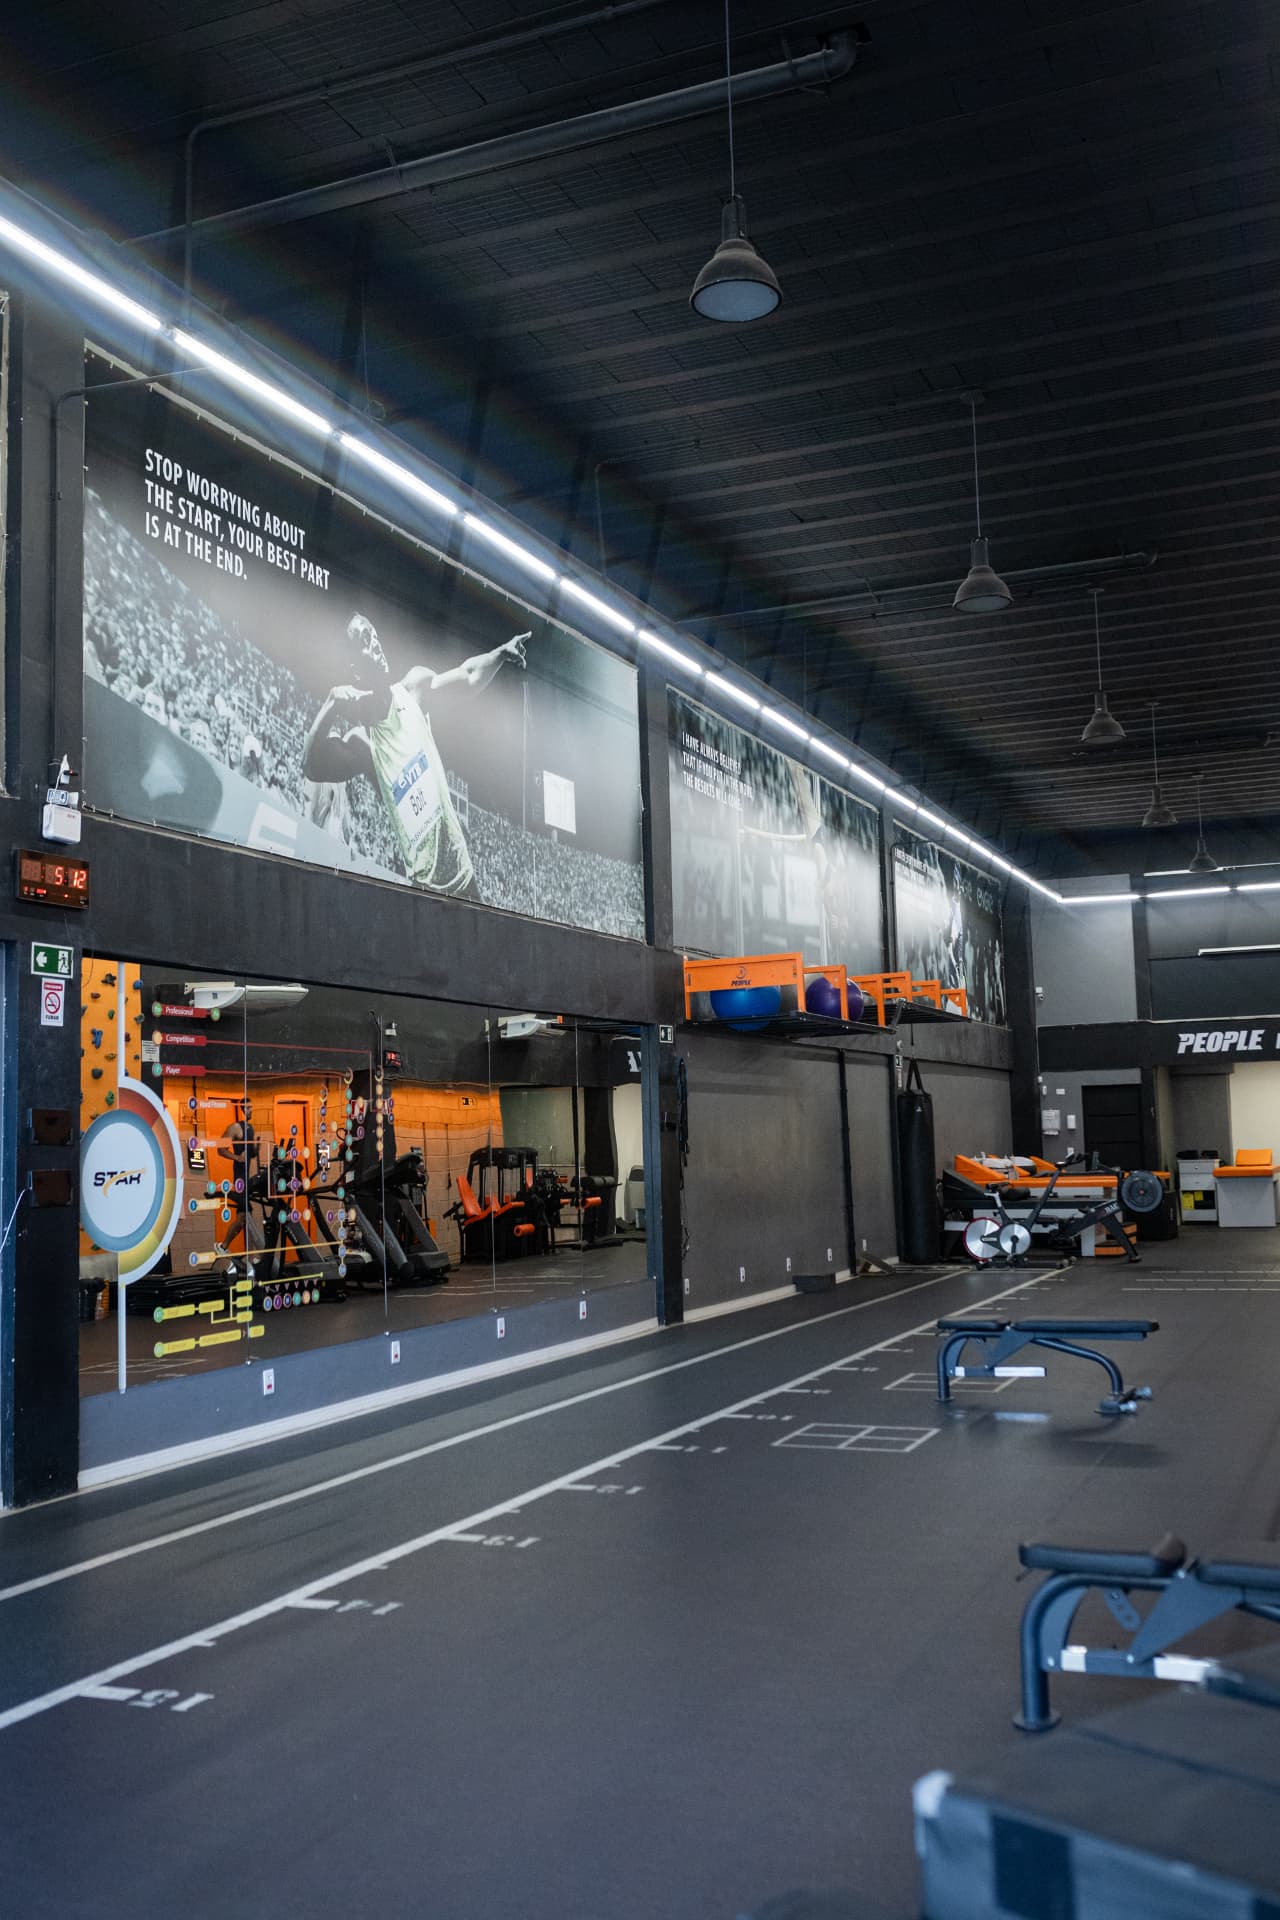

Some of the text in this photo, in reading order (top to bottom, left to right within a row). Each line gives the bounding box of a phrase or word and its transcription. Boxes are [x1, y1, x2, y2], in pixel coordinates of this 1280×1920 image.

[145, 448, 305, 550] STOP WORRYING ABOUT
[145, 479, 330, 590] THE START, YOUR BEST PART
[145, 511, 248, 580] IS AT THE END.
[686, 733, 699, 752] HAVE
[683, 771, 694, 789] THE
[694, 776, 715, 799] RESULTS
[165, 1006, 194, 1016] Professional
[165, 1034, 195, 1043] Competition
[1177, 1029, 1265, 1054] PEOPLE
[165, 1066, 181, 1075] Player
